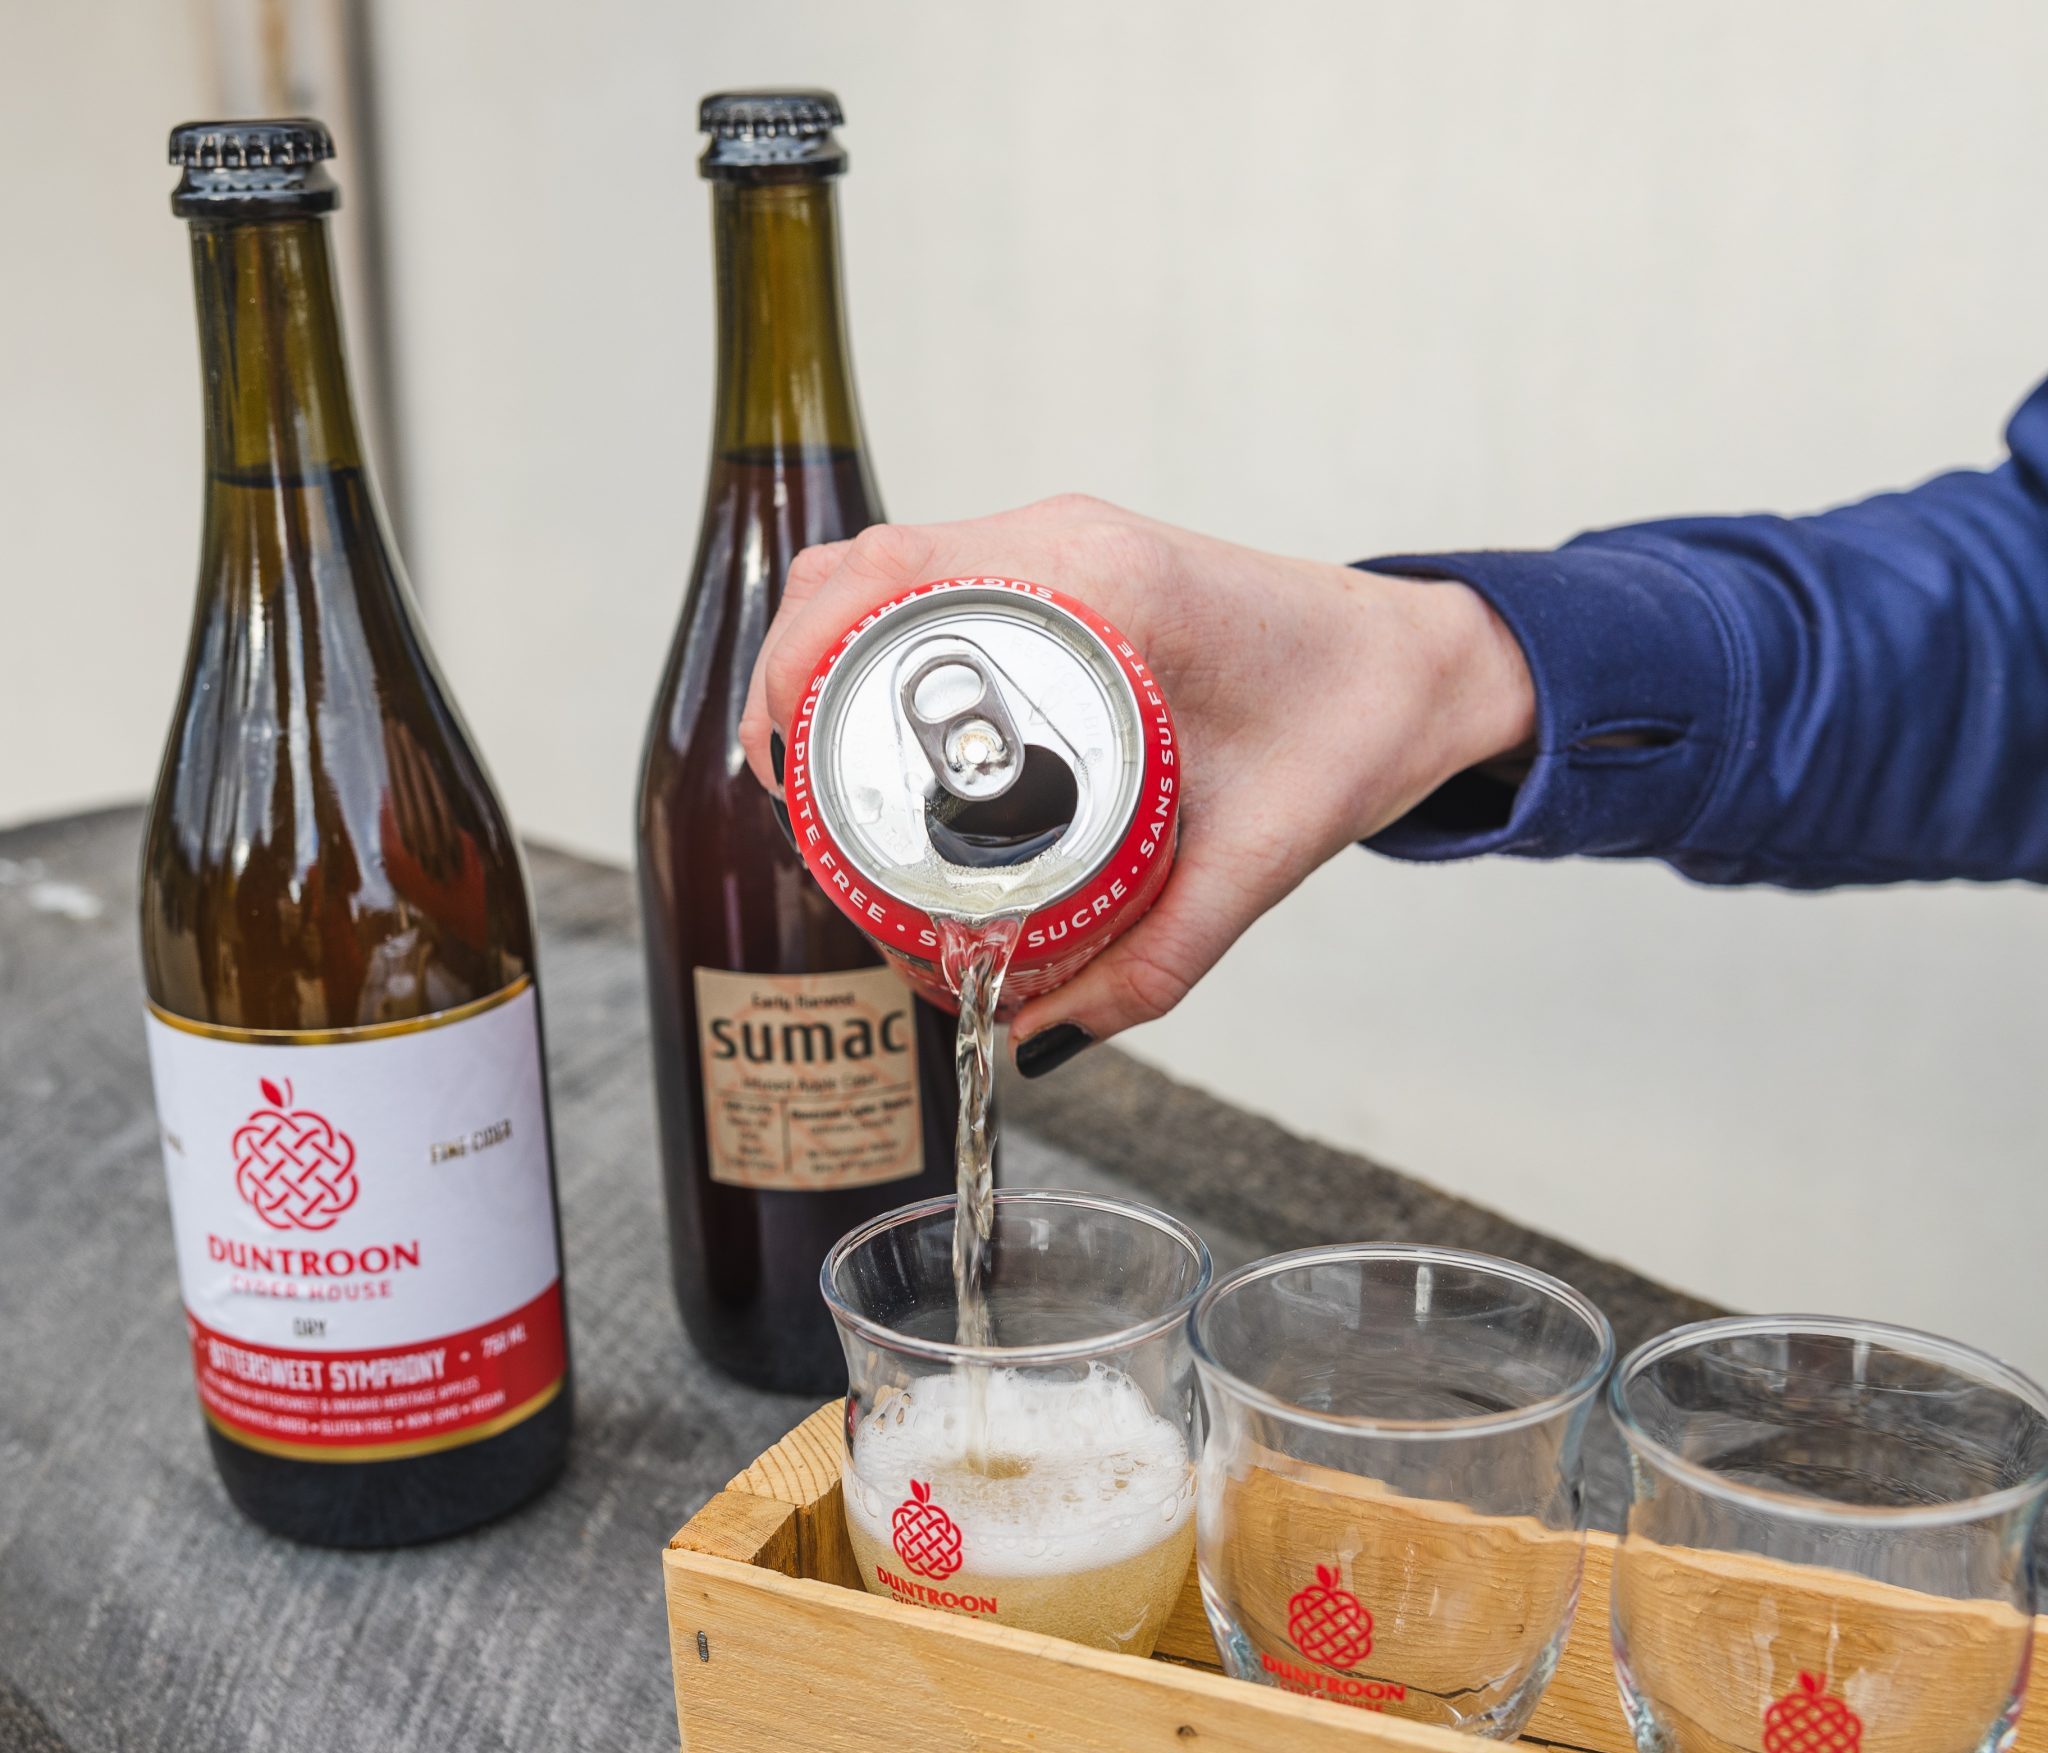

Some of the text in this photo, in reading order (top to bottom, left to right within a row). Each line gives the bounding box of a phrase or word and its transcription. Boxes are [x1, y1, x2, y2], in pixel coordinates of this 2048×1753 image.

[842, 577, 1054, 645] SUGAR FREE
[1117, 640, 1174, 858] SANS SULFITE
[793, 675, 886, 923] SULPHITE FREE
[1027, 878, 1127, 948] SUCRE
[208, 1232, 421, 1277] DUNTROON
[308, 1279, 393, 1303] HOUSE
[208, 1336, 324, 1392] BITTERSWEET
[328, 1347, 447, 1392] SYMPHONY
[876, 1564, 998, 1615] DUNTROON
[1261, 1652, 1407, 1702] DUNTROON
